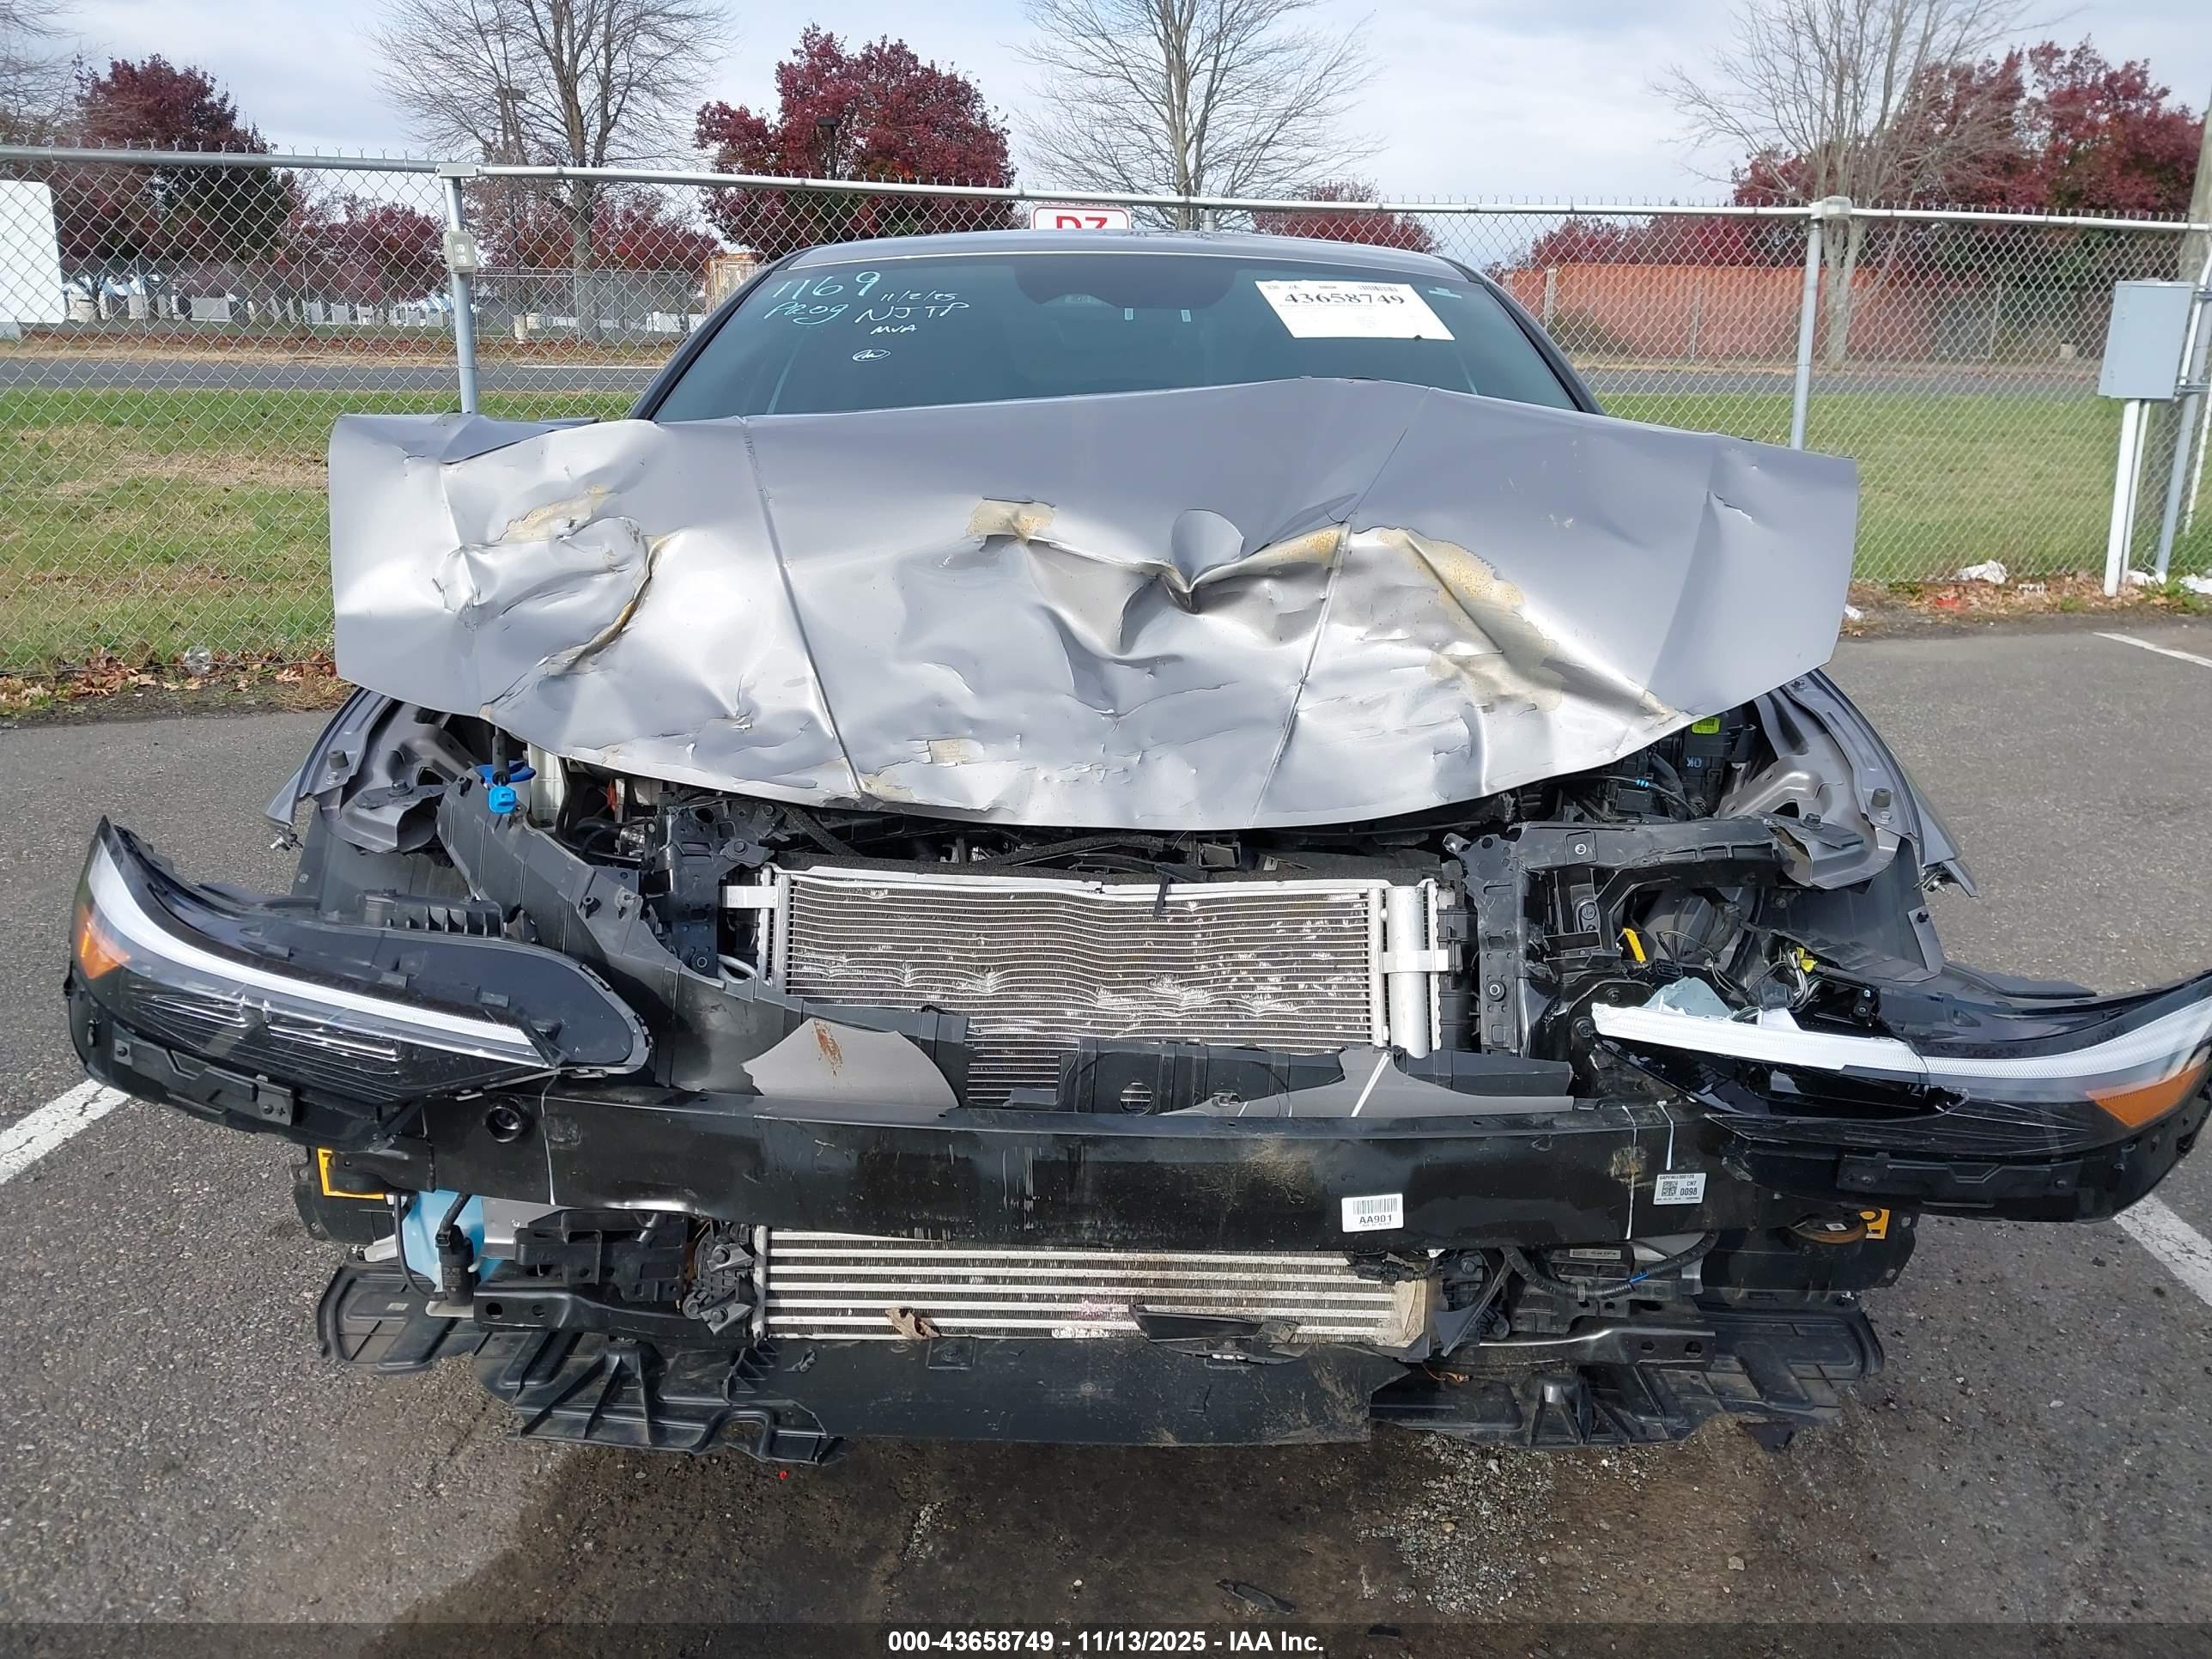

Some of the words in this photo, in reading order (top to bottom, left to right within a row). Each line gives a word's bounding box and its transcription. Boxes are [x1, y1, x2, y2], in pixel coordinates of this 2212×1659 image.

[773, 271, 881, 300] 1169
[1285, 293, 1406, 305] 43658749
[1359, 1213, 1393, 1224] AA901
